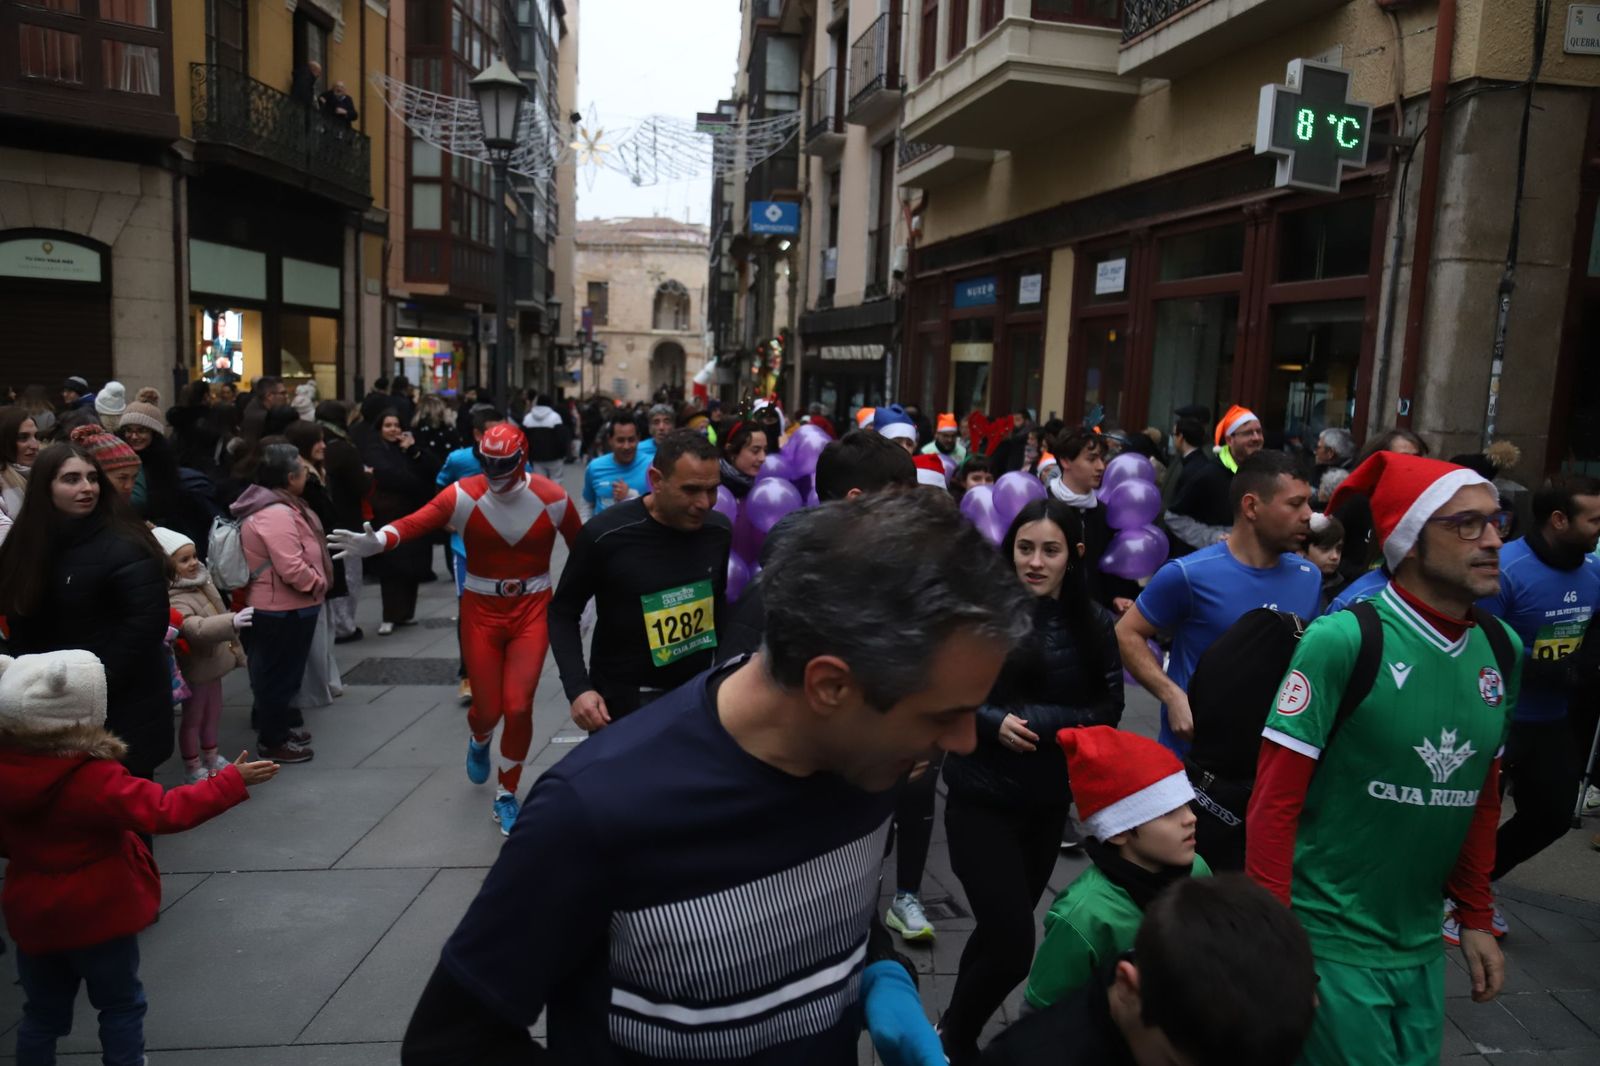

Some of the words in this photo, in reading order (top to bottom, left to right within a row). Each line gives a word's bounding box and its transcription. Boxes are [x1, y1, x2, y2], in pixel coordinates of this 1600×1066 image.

[1296, 108, 1315, 141] 8
[1563, 590, 1578, 603] 46
[652, 607, 704, 646] 1282
[1367, 780, 1426, 806] CAJA
